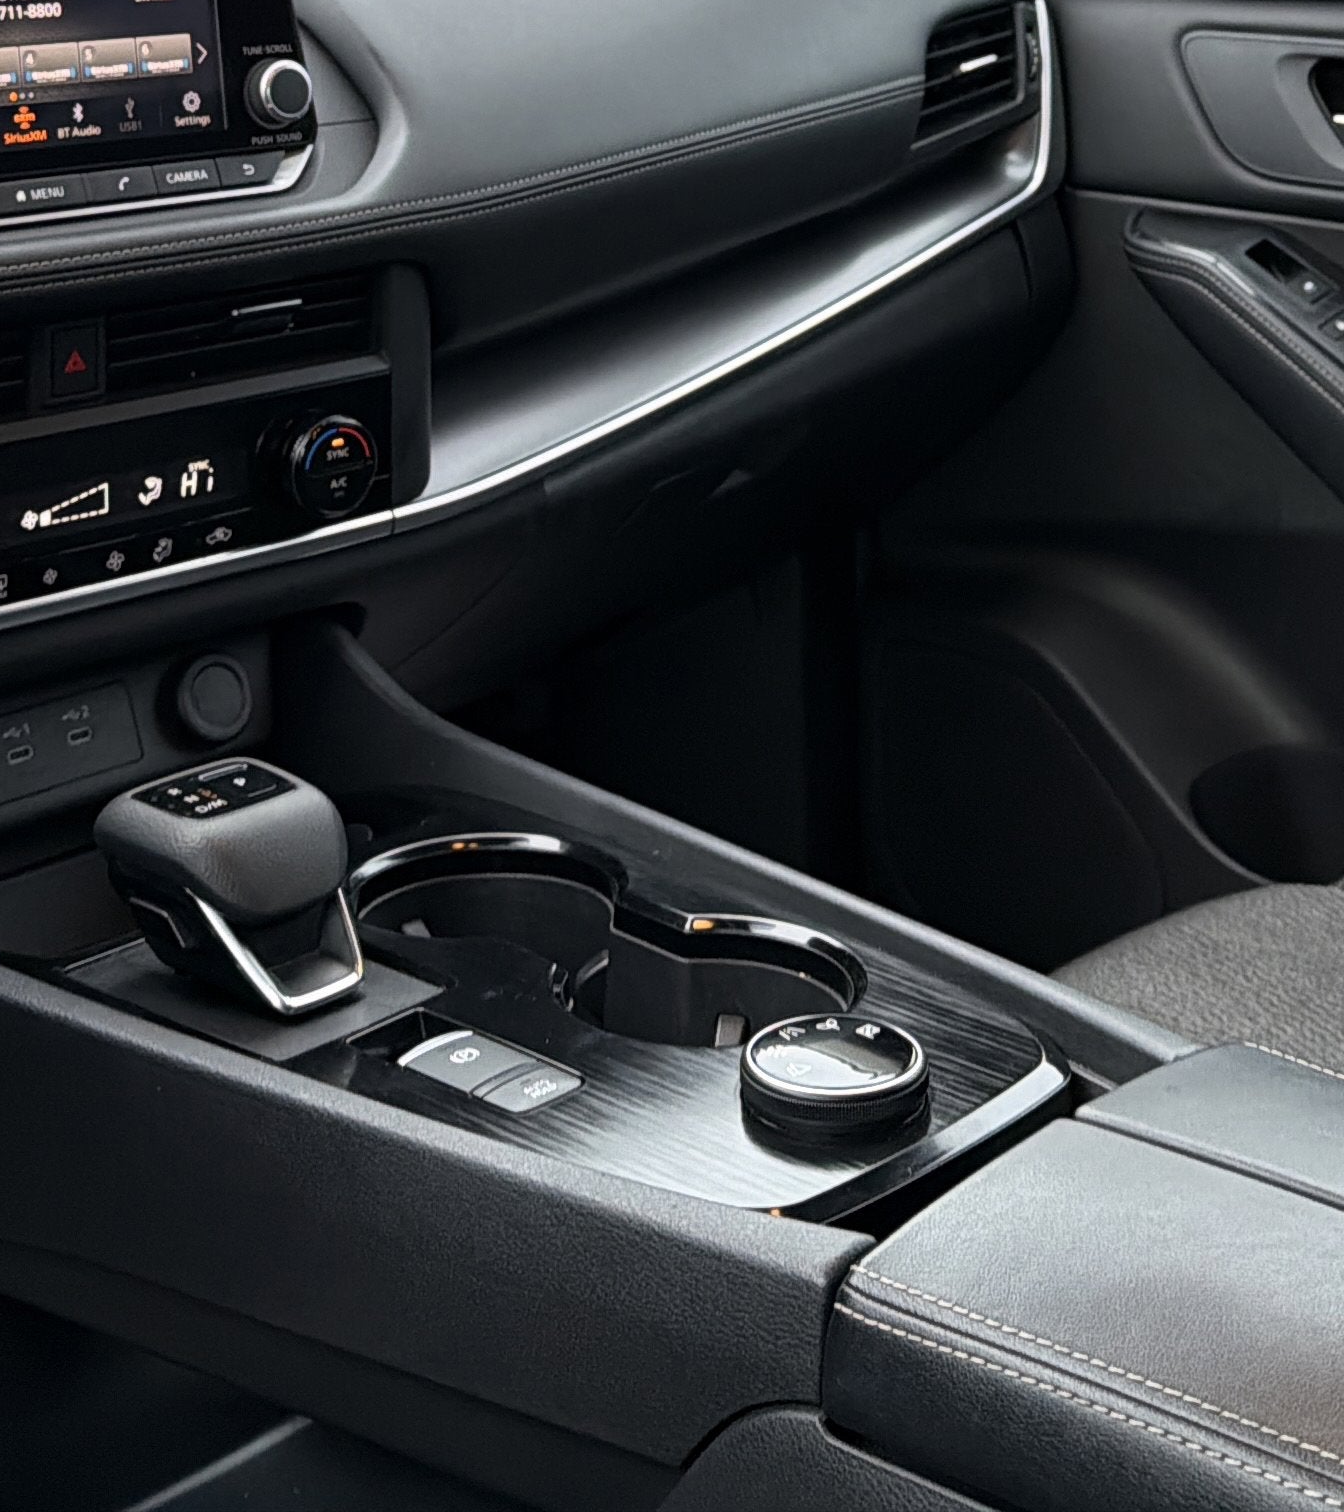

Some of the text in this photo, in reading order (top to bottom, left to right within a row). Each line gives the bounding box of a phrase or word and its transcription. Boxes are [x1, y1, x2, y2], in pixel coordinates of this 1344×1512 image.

[174, 114, 211, 128] Settings
[57, 125, 102, 139] BT Audio
[166, 169, 208, 184] CAMERA
[30, 186, 65, 200] MENU
[326, 447, 349, 461] SYNC
[180, 467, 214, 498] Hi
